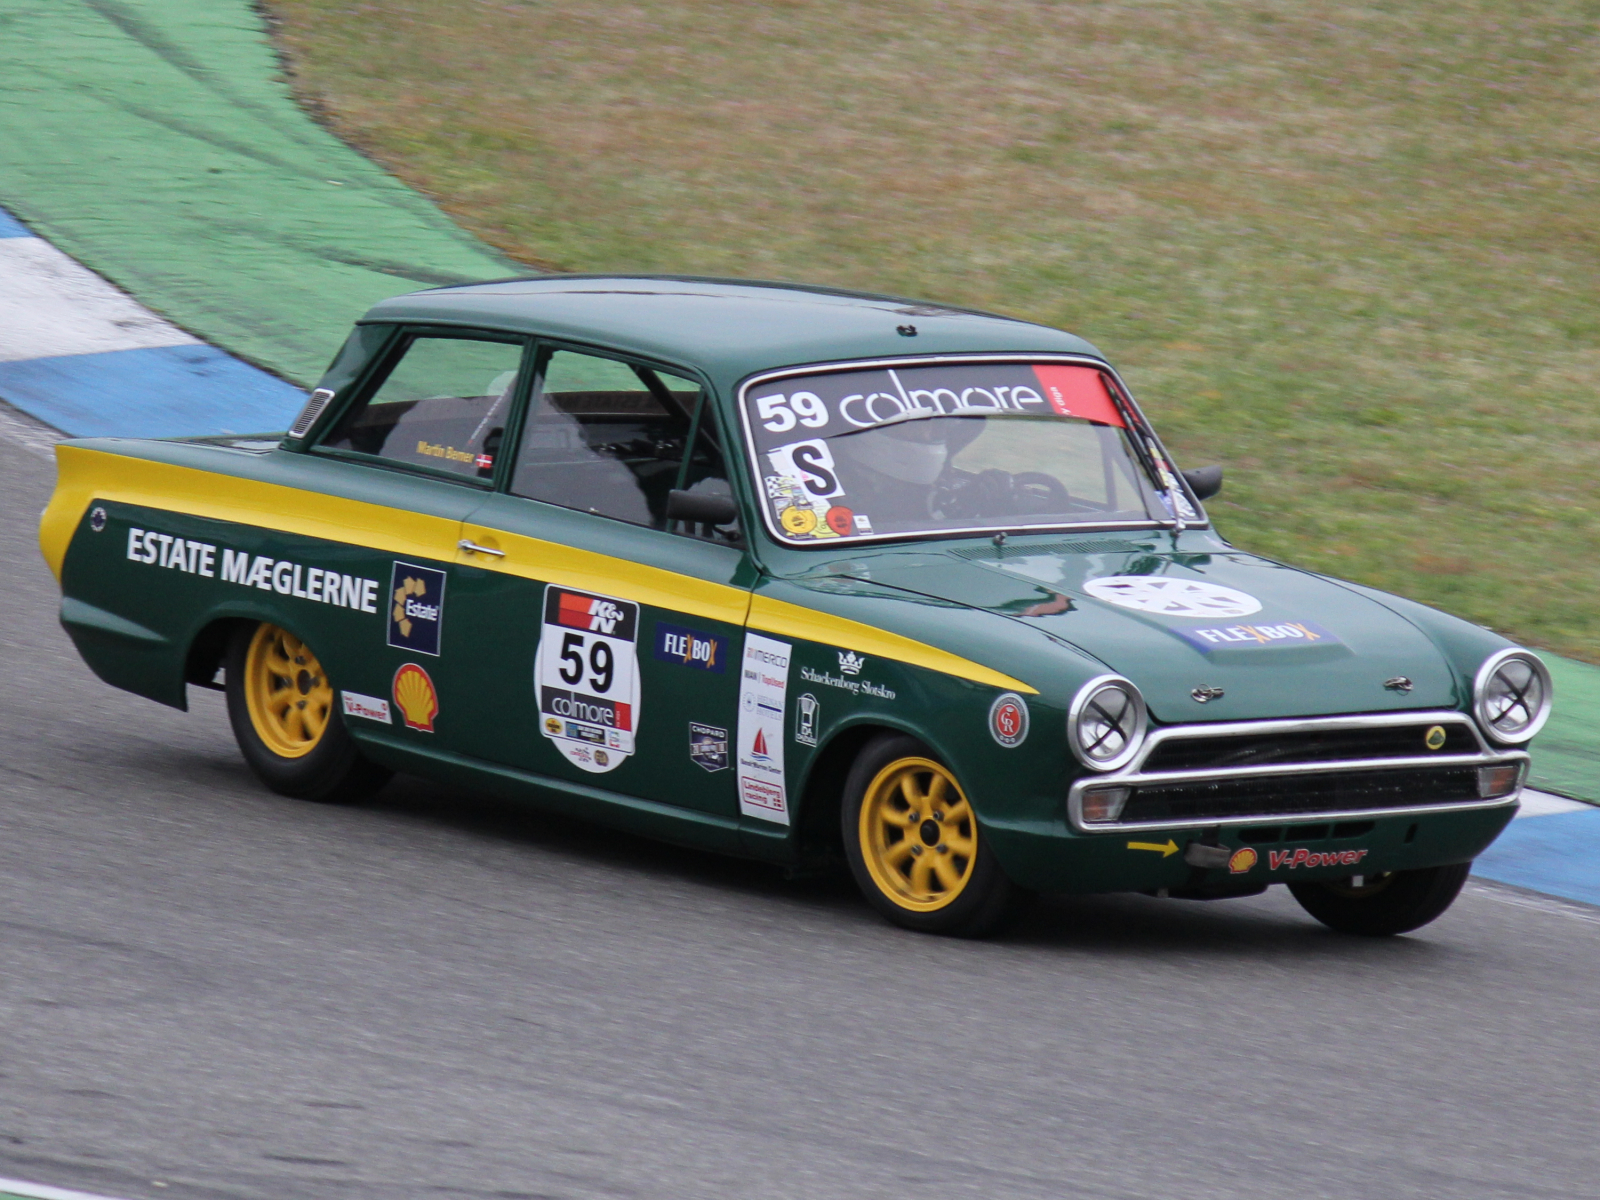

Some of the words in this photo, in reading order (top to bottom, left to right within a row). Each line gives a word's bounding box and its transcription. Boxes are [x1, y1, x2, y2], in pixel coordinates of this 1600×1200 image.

[756, 391, 829, 433] 59
[839, 369, 1044, 428] colmore
[792, 445, 837, 496] S
[127, 528, 216, 578] ESTATE
[221, 549, 380, 614] MÆGLERNE
[405, 599, 438, 622] Estate
[587, 598, 625, 635] K&N
[1195, 622, 1321, 644] FLEXBOX
[559, 632, 615, 694] 59
[664, 633, 718, 669] FLEXBOX
[801, 666, 860, 696] Schackenborg
[861, 680, 896, 700] Slotskro
[344, 700, 388, 721] V-Power
[552, 691, 614, 726] colmore
[1268, 848, 1369, 871] V-Power
